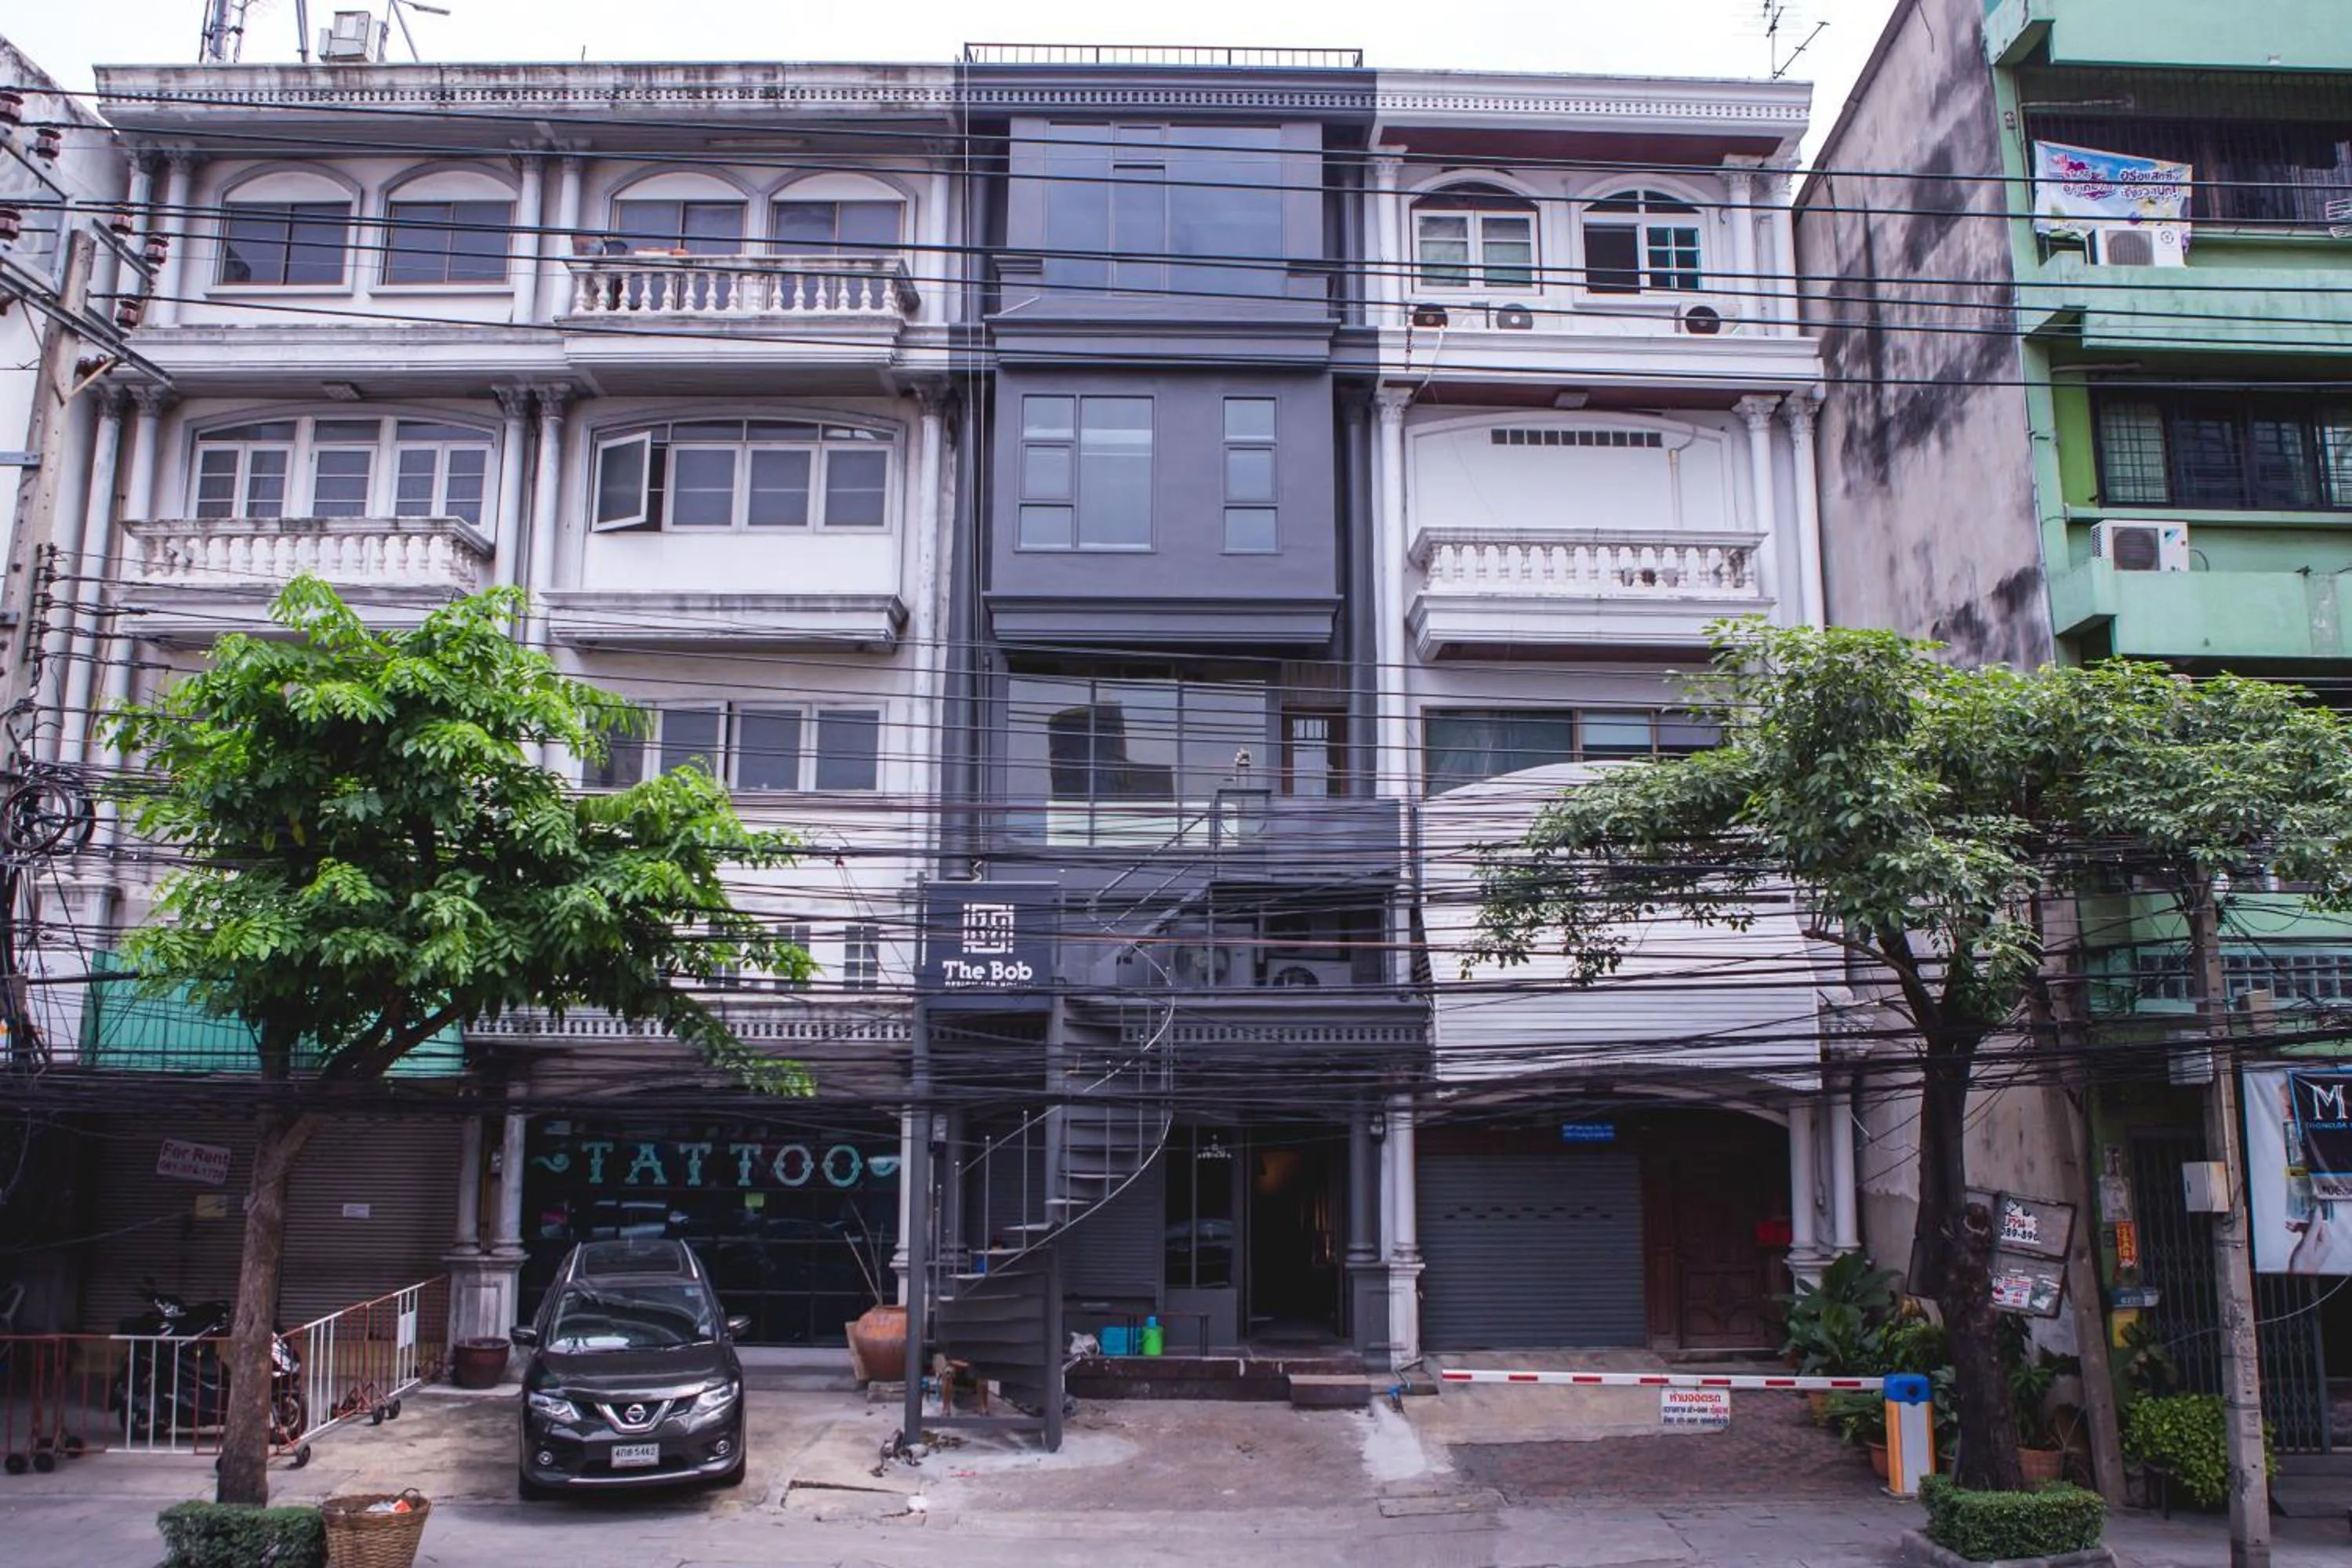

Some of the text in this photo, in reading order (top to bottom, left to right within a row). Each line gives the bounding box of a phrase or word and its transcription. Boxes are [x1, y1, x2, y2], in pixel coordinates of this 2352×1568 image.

[942, 960, 1033, 981] The Bob
[2311, 1084, 2348, 1120] M
[162, 1142, 230, 1168] For Rent
[582, 1142, 862, 1186] TATTOO
